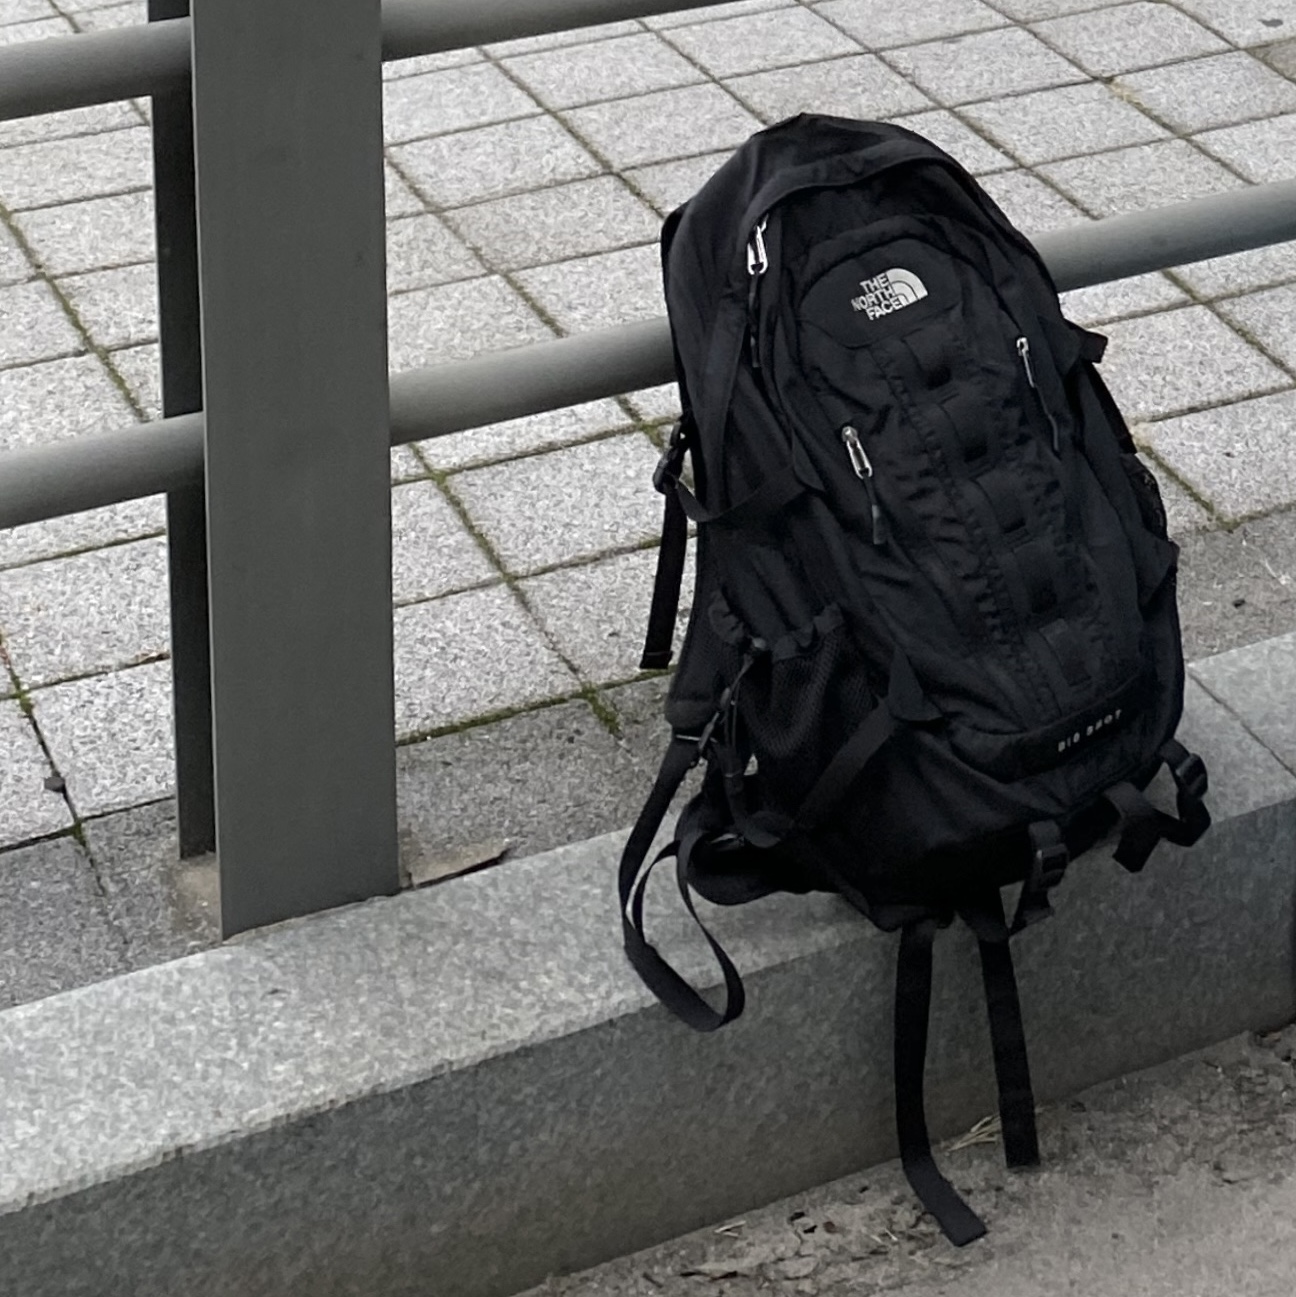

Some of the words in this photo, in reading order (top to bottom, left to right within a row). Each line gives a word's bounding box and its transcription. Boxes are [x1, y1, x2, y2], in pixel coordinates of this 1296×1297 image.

[859, 272, 890, 294] THE
[850, 285, 896, 312] NORTH
[865, 296, 903, 321] FACE
